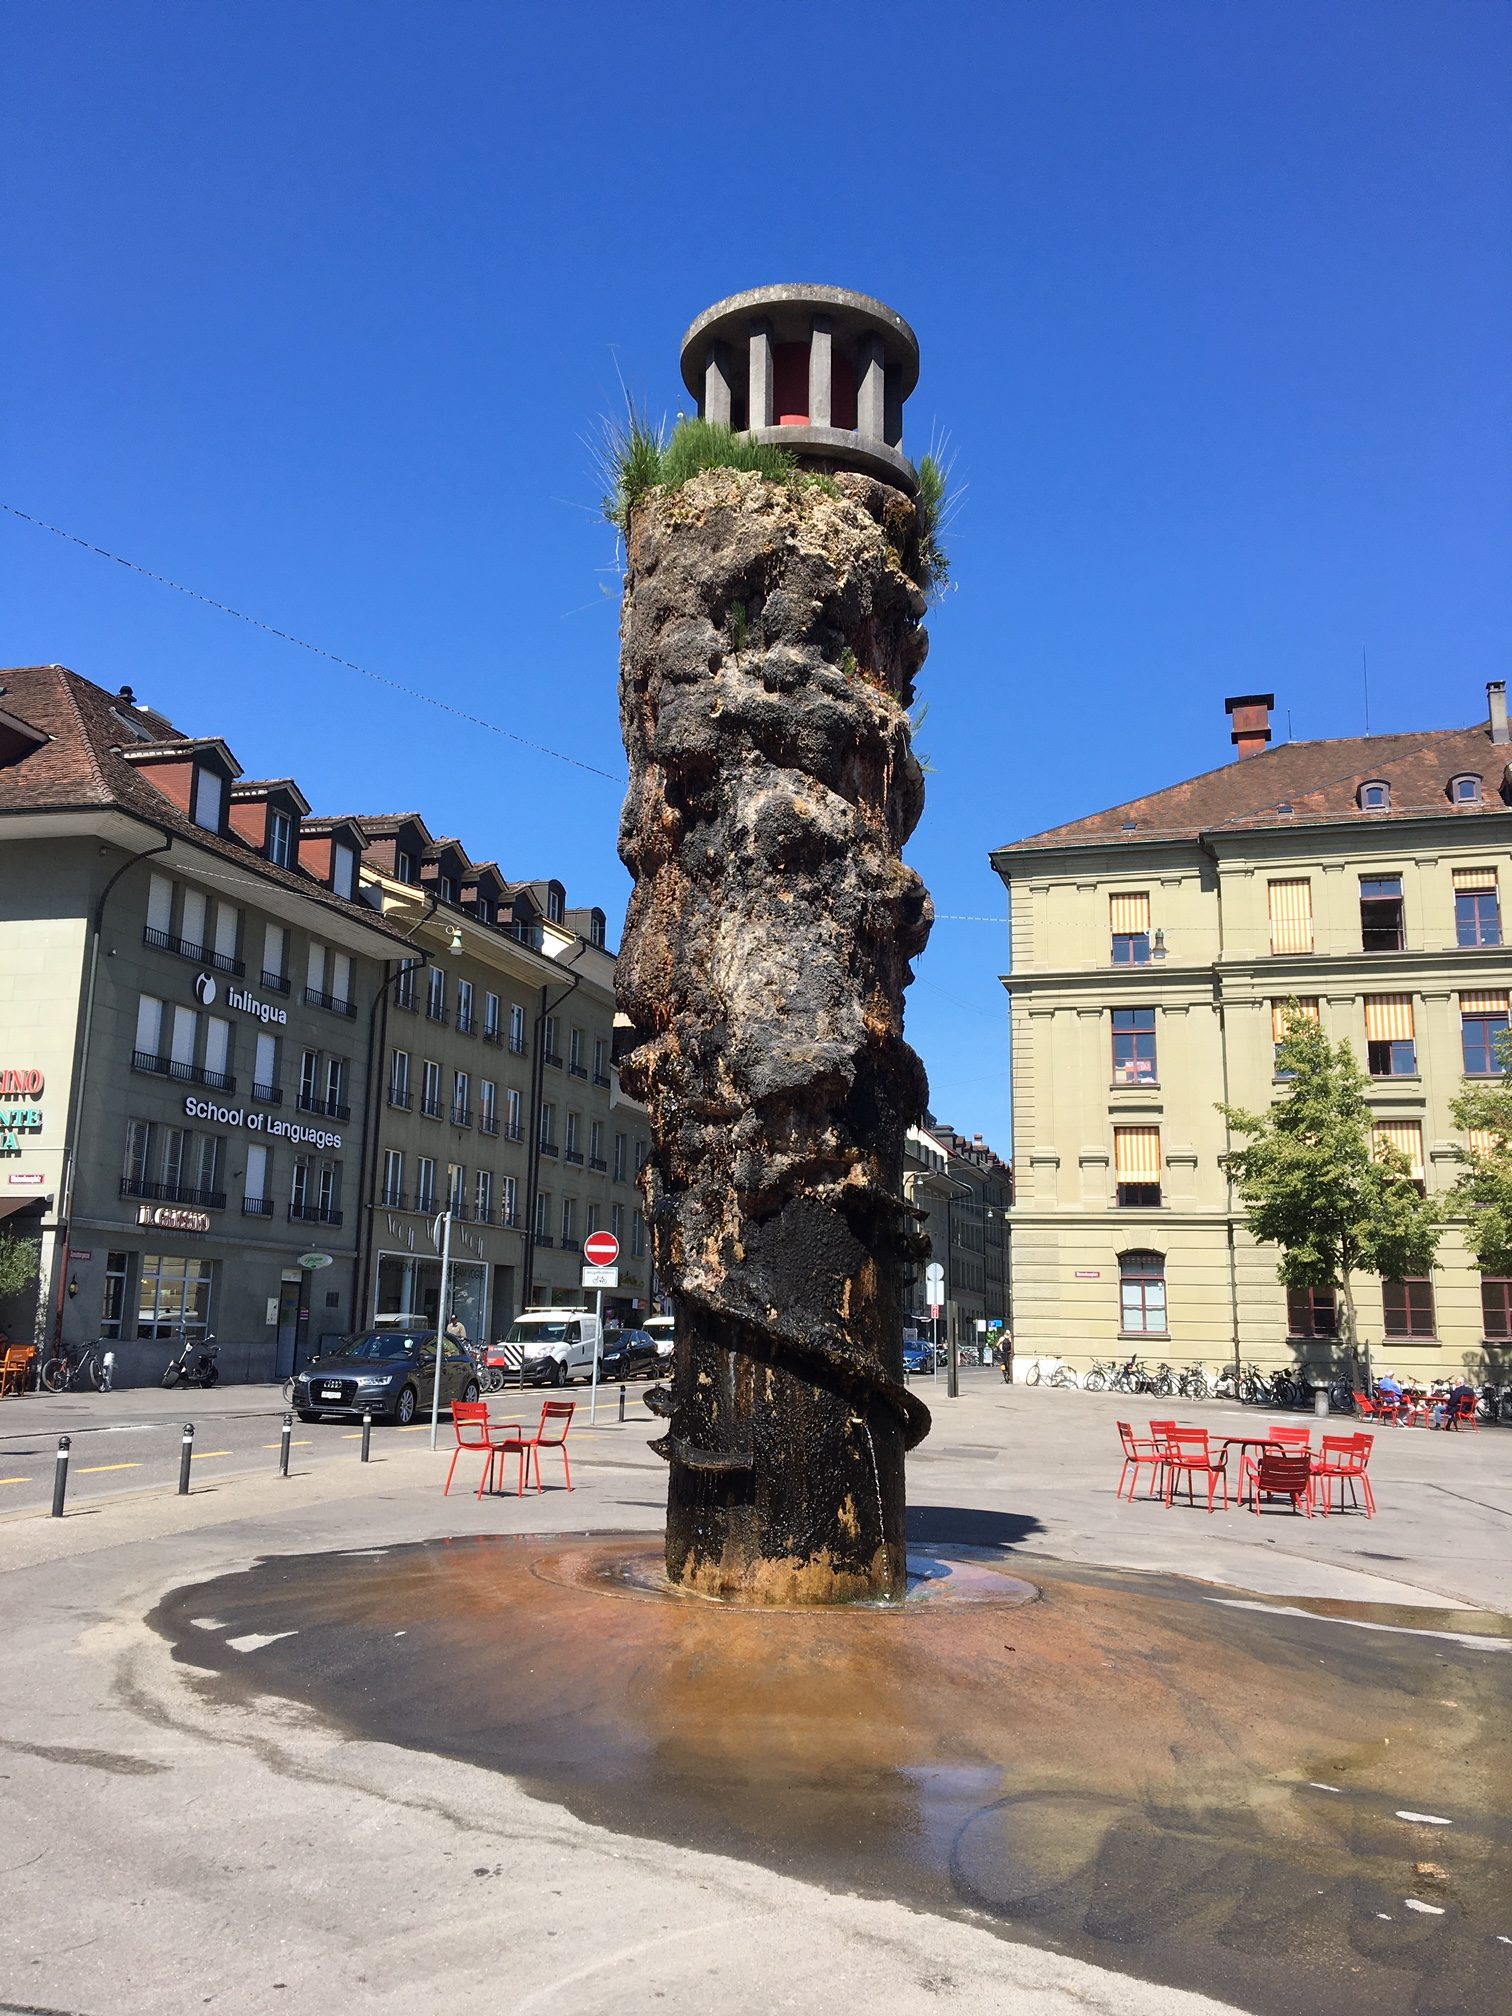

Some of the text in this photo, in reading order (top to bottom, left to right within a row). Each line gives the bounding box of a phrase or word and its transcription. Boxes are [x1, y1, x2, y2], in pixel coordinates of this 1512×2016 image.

[228, 986, 288, 1025] inlingua
[185, 1096, 342, 1149] School of Languages
